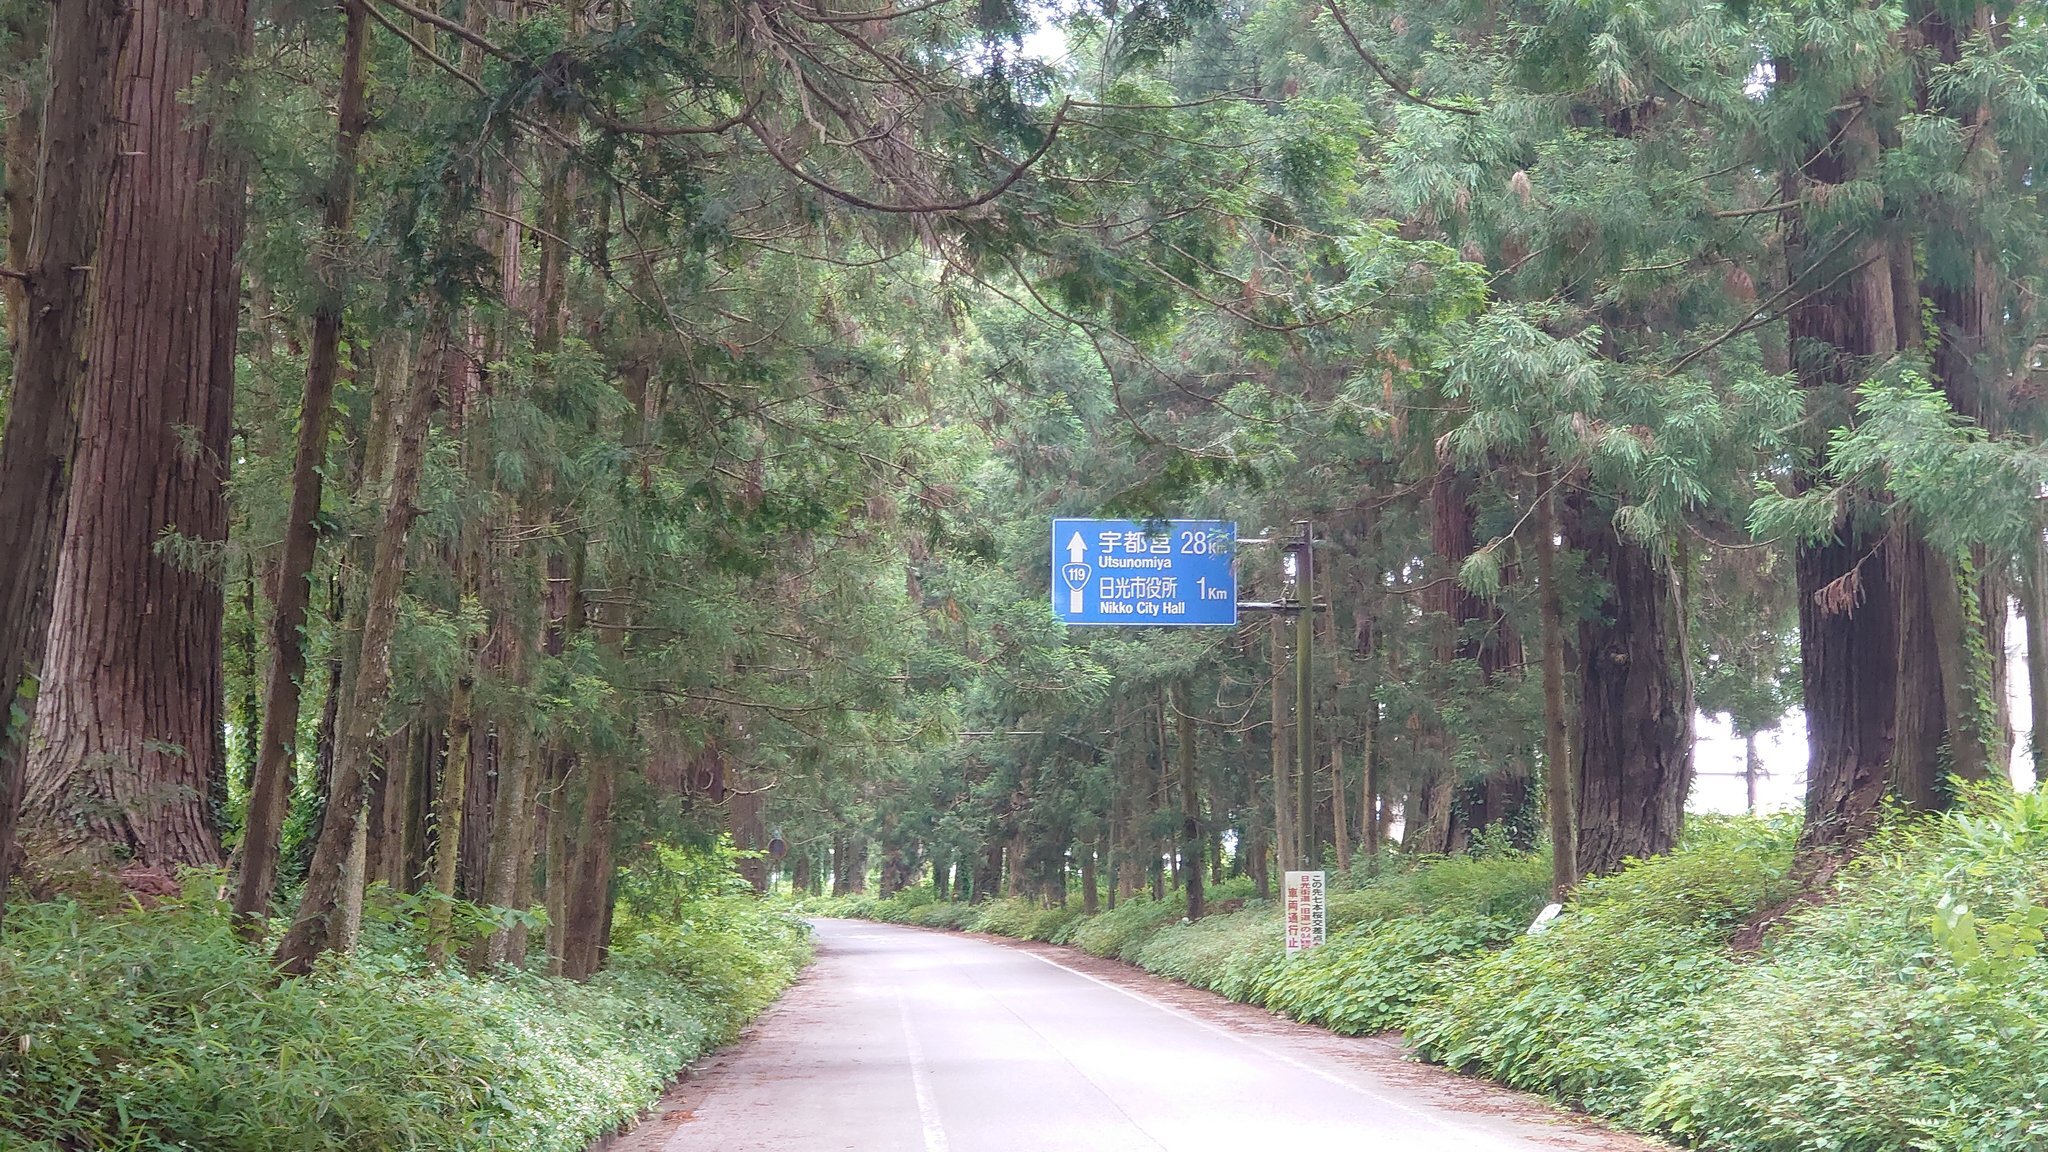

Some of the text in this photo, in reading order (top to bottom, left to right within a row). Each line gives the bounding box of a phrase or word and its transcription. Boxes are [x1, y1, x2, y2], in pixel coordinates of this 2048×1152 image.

[1099, 531, 1171, 554] 宇都宮
[1099, 556, 1172, 571] Utsunomiya
[1068, 568, 1085, 581] 119
[1100, 577, 1177, 600] 日光市役所
[1100, 601, 1185, 617] Nikko City Hall
[1288, 887, 1299, 948] 車両通行止
